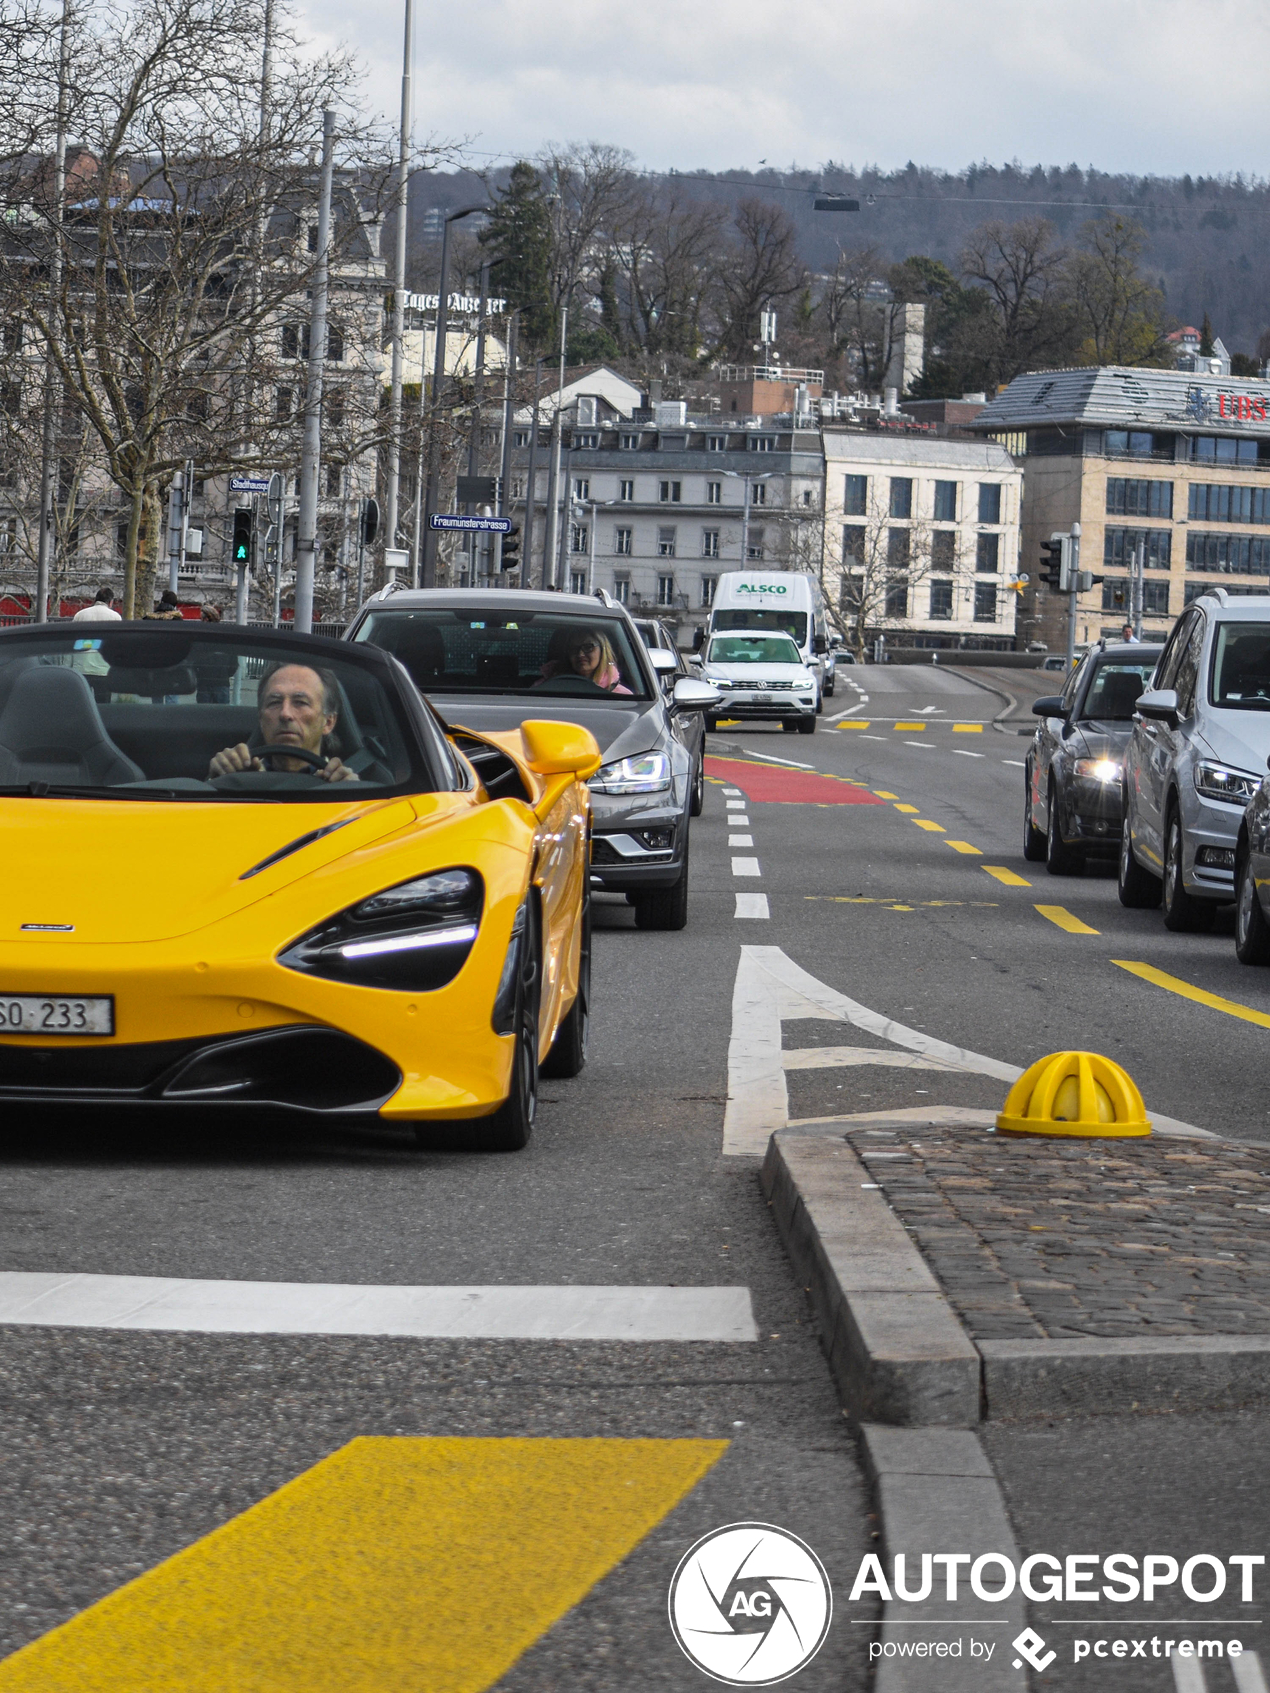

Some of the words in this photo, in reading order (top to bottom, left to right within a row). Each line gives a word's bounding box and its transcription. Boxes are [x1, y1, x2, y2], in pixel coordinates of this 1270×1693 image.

[1219, 394, 1267, 421] UBS
[232, 479, 269, 492] Stadthausqu
[433, 515, 508, 530] Fraumünsterstrasse
[736, 583, 787, 594] ALSCO
[41, 1002, 87, 1028] 233
